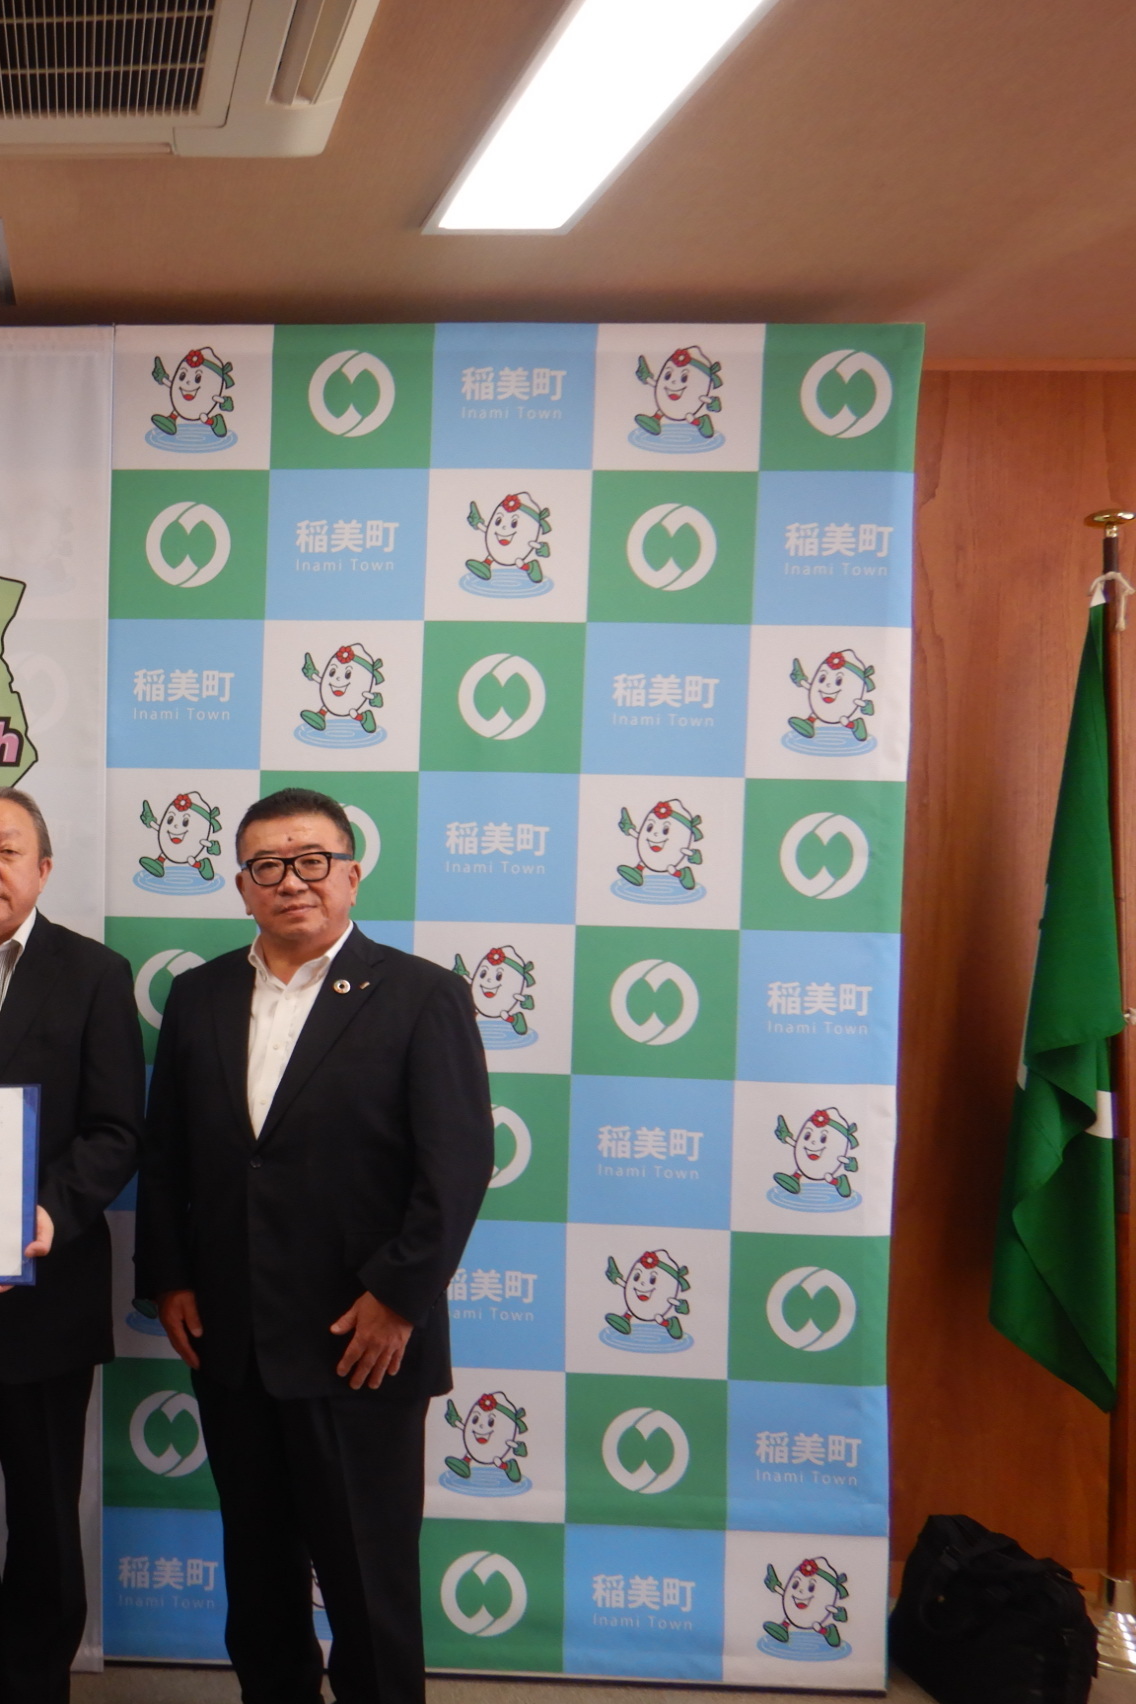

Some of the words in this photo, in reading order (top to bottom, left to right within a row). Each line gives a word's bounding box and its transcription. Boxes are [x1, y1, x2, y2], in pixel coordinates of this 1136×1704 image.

[461, 367, 566, 401] 稲美町
[461, 406, 508, 420] Inami
[516, 406, 561, 420] Town
[295, 520, 399, 553] 稲美町
[784, 523, 893, 557] 稲美町
[295, 558, 342, 572] Inami
[350, 558, 393, 572] Town
[784, 562, 833, 576] Inami
[841, 562, 887, 576] Town
[133, 669, 234, 702] 稲美町
[612, 674, 719, 708] 稲美町
[133, 707, 179, 720] Inami
[186, 707, 230, 720] Town
[612, 713, 661, 727] Inami
[668, 713, 714, 727] Town
[445, 822, 549, 856] 稲美町
[445, 860, 493, 874] Inami
[500, 860, 545, 874] Town
[767, 981, 872, 1016] 稲美町
[766, 1020, 817, 1035] Inami
[823, 1020, 868, 1035] Town
[597, 1125, 703, 1161] 稲美町
[597, 1163, 646, 1178] Inami
[653, 1164, 699, 1179] Town
[453, 1307, 482, 1319] ami
[489, 1307, 534, 1321] Town
[755, 1431, 861, 1467] 稲美町
[755, 1468, 804, 1483] Inami
[811, 1470, 857, 1486] Town
[119, 1556, 218, 1590] 稲美町
[592, 1574, 695, 1612] 稲美町
[592, 1613, 640, 1628] Inami
[646, 1614, 693, 1630] Town
